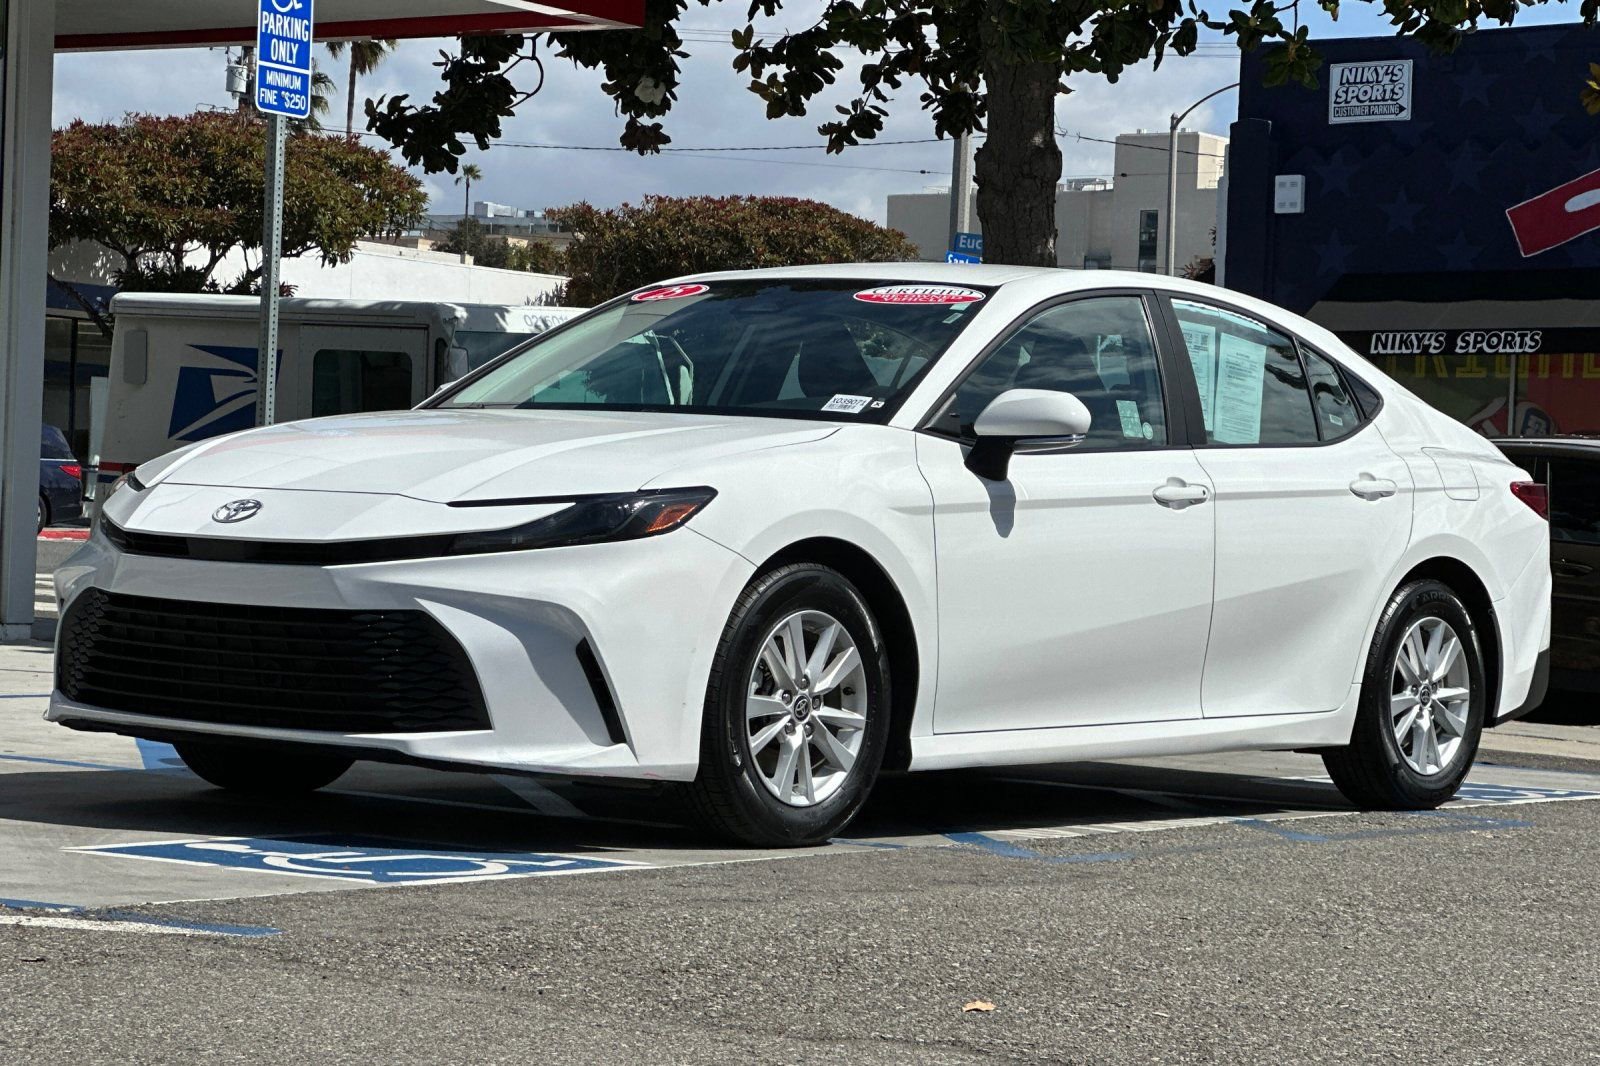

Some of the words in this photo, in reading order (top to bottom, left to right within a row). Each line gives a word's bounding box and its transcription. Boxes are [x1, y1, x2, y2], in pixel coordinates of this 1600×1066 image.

[262, 11, 309, 42] PARKING
[271, 38, 299, 64] ONLY
[266, 70, 301, 90] MINIMUM
[1340, 64, 1404, 85] NIKY'S
[260, 88, 278, 105] FINE
[284, 92, 306, 110] $250
[1334, 83, 1404, 104] SPORTS
[1334, 107, 1369, 116] CUSTOMER
[1370, 104, 1399, 115] PARKING
[873, 287, 974, 296] CERTIFIED
[1370, 332, 1446, 354] NIKY'S
[1455, 331, 1542, 353] SPORTS
